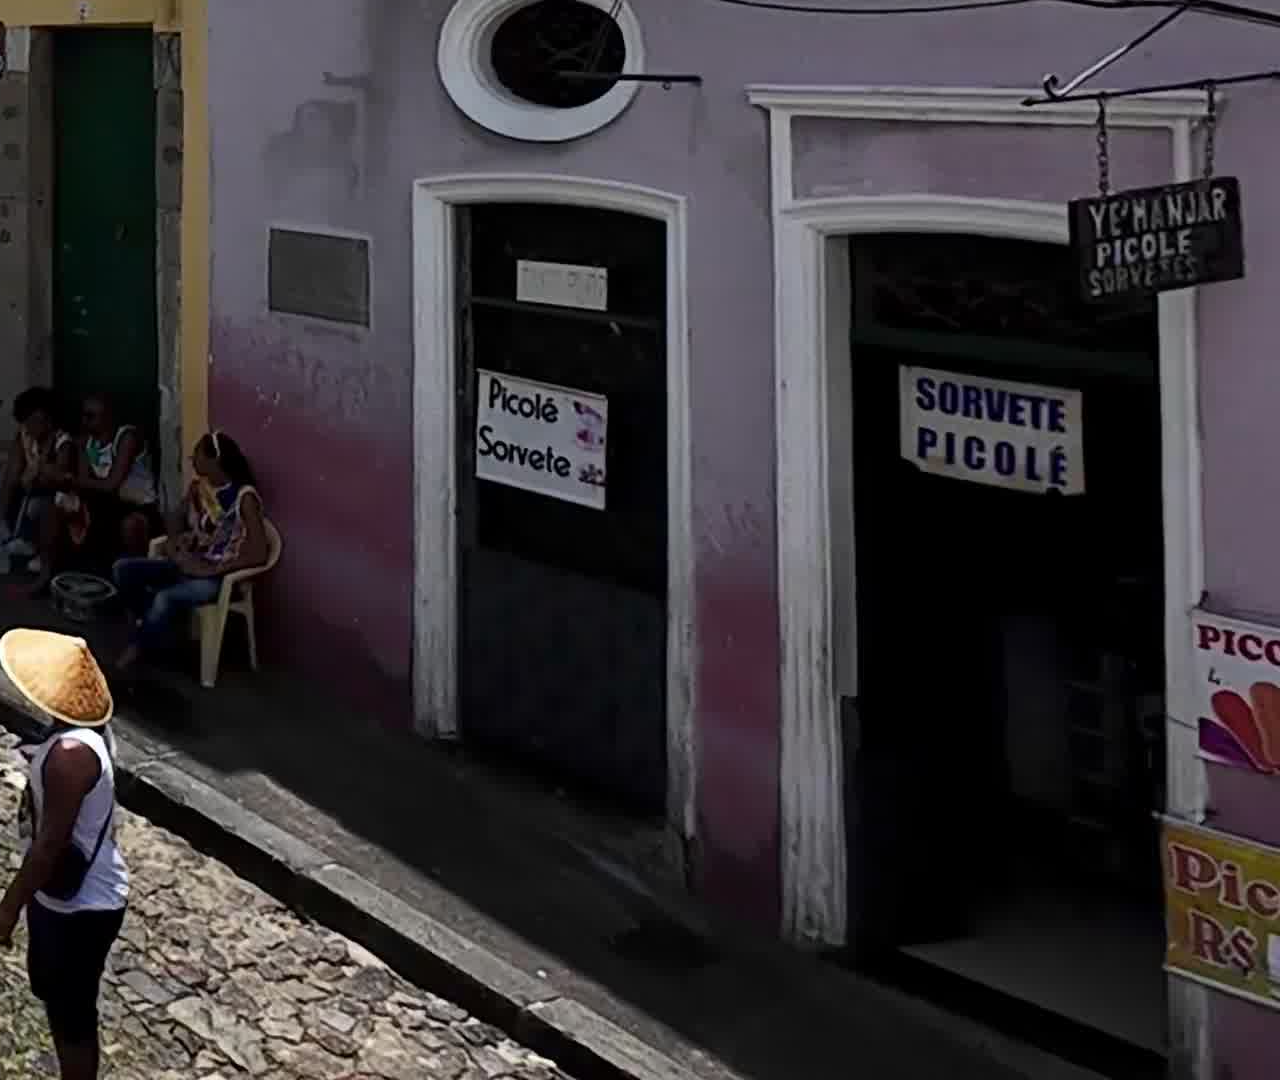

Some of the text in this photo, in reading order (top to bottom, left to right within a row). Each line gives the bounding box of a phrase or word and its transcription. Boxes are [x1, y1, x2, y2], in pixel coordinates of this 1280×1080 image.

[1096, 228, 1192, 268] PICOLE
[489, 376, 560, 424] Picolé
[915, 376, 1067, 434] SORVETE
[478, 424, 572, 478] Sorvete
[917, 425, 1068, 487] PICOLÉ
